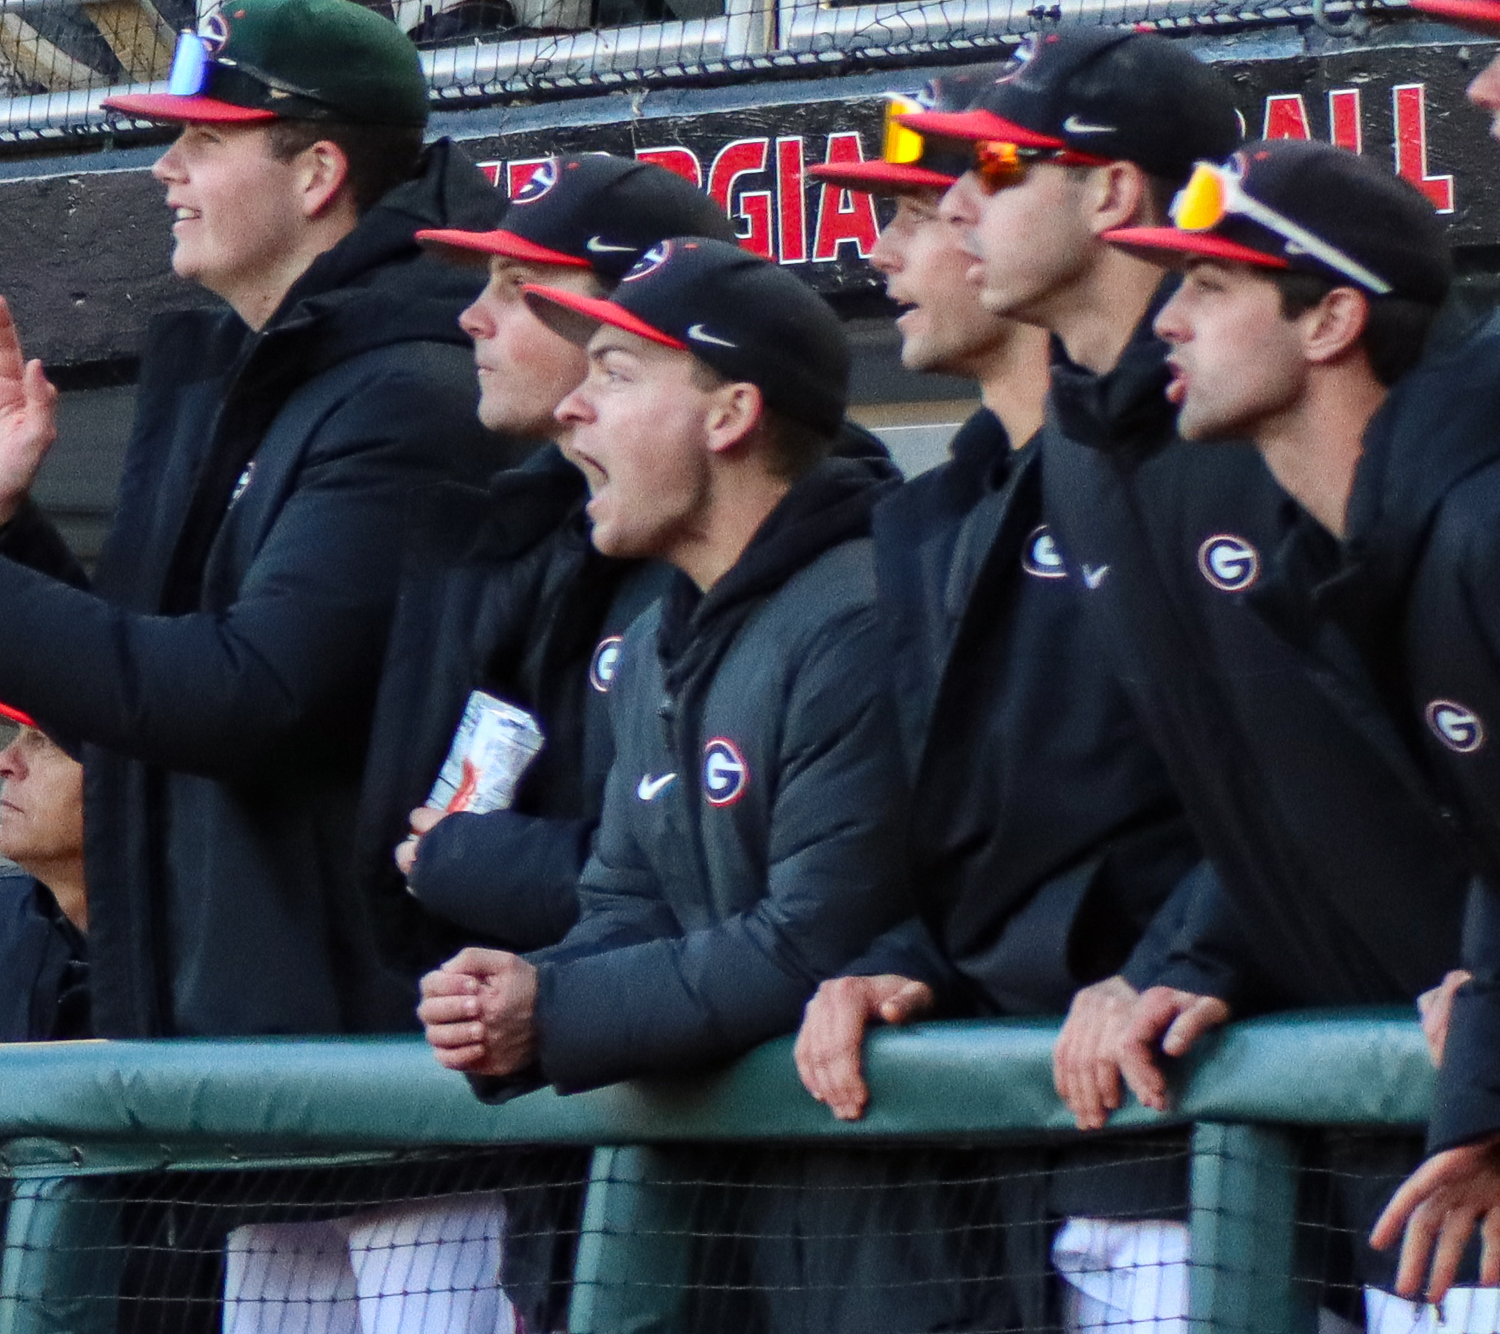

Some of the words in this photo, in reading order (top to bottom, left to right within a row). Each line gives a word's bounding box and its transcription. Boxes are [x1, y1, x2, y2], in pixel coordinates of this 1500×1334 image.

[1195, 533, 1261, 592] G
[1425, 699, 1483, 754] G
[703, 736, 752, 808] G
